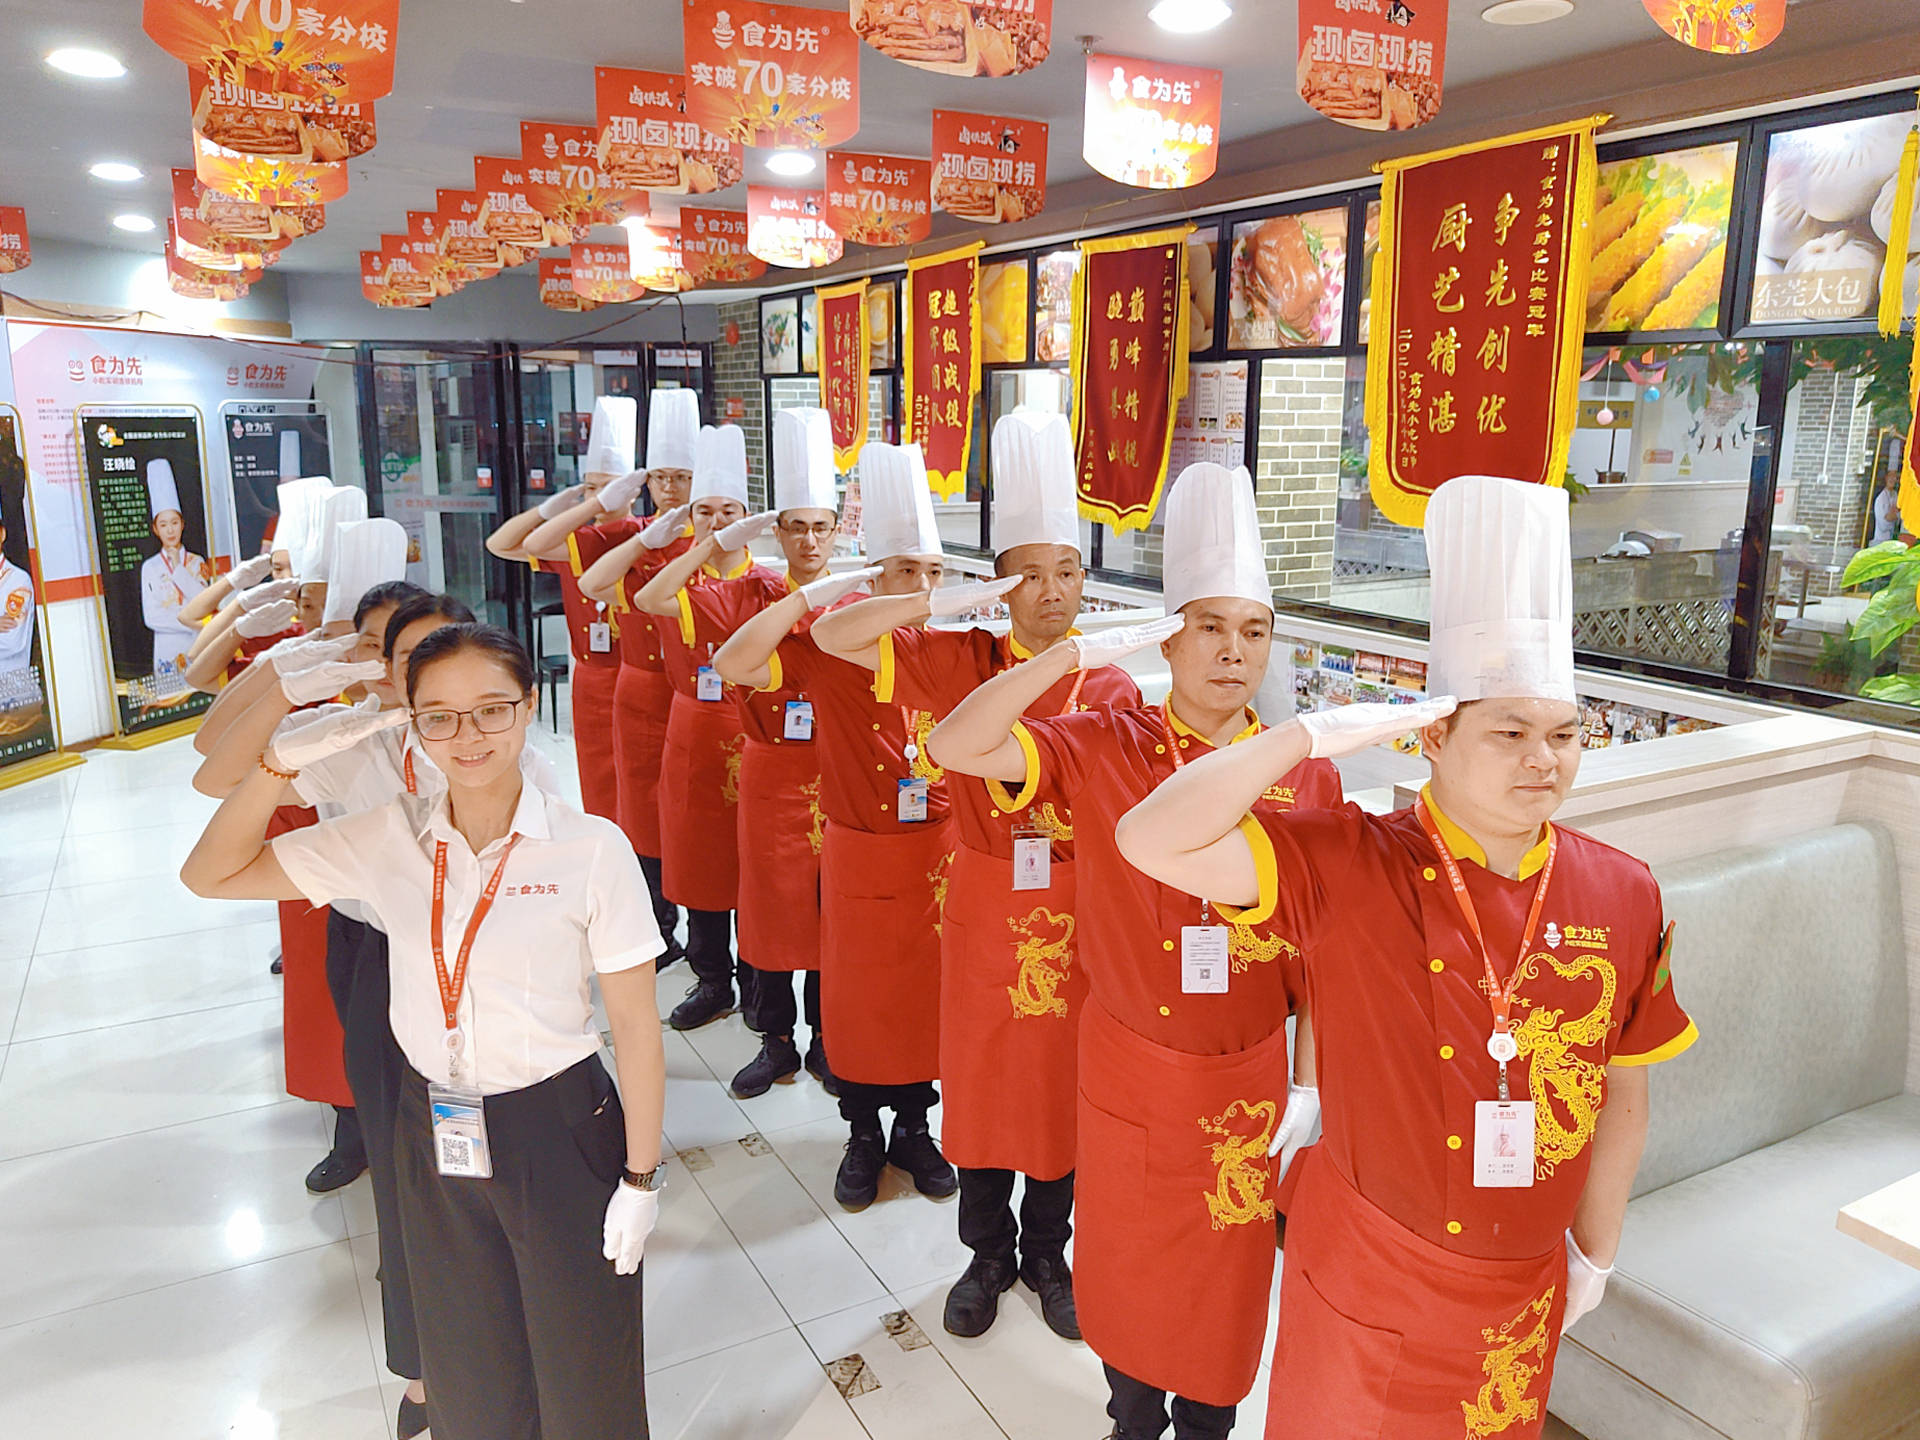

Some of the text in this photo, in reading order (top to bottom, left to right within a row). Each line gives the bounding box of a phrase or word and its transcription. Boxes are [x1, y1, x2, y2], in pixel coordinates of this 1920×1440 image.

[741, 21, 819, 54] 食为先
[1312, 25, 1433, 76] 现卤现捞
[691, 59, 851, 100] 突破70家分校
[1132, 75, 1192, 105] 食为先
[861, 166, 909, 187] 食为先
[941, 152, 1036, 186] 现卤现捞
[829, 189, 927, 215] 突破70家分校
[709, 218, 746, 235] 食为先
[1754, 276, 1861, 308] 东莞大包
[1427, 203, 1473, 434] 厨艺精湛
[1476, 192, 1521, 434] 争先创优
[90, 354, 142, 376] 食为先
[245, 362, 288, 381] 食为先
[520, 883, 560, 896] 食为先
[1563, 925, 1607, 942] 食为先
